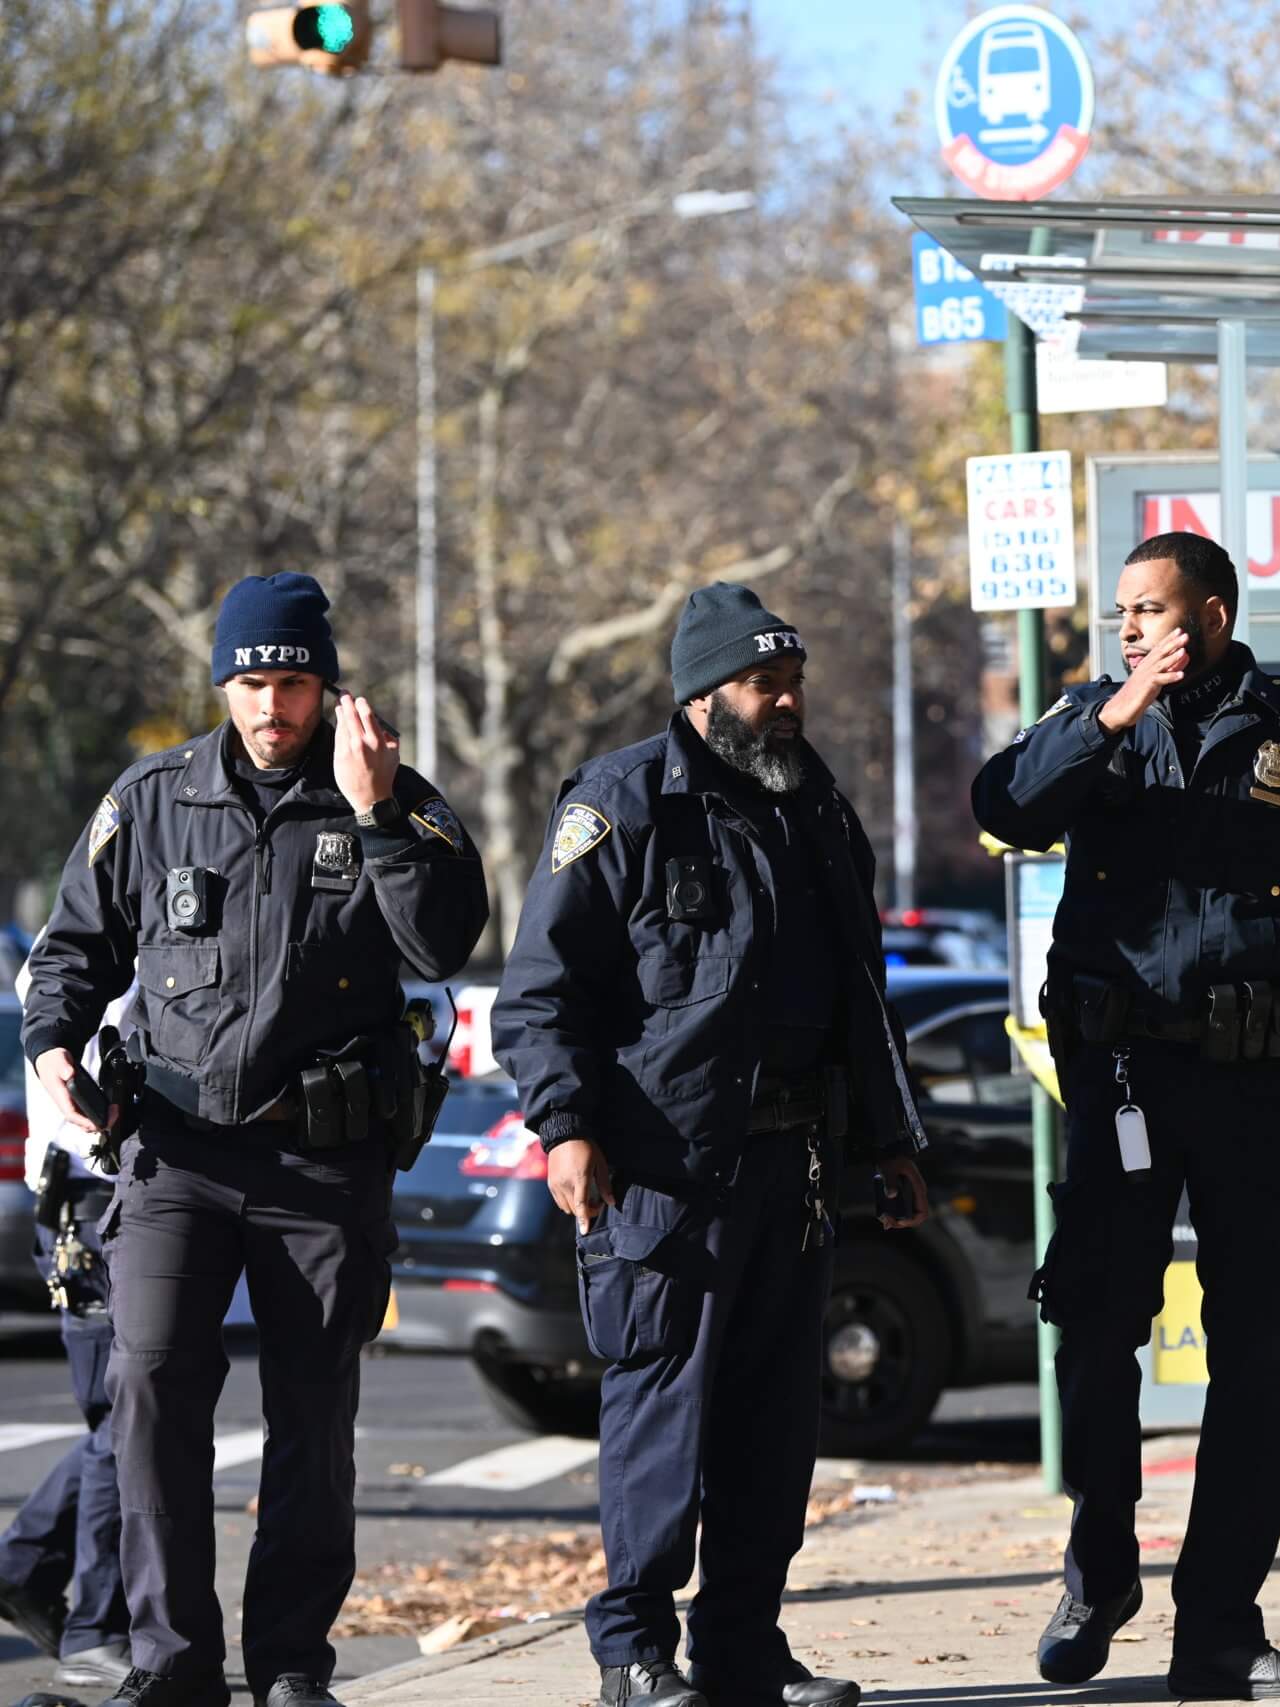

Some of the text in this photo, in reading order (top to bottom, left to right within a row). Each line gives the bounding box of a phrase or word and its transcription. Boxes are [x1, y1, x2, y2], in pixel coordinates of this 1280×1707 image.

[922, 296, 985, 341] B65
[984, 497, 1056, 521] CARS
[991, 552, 1056, 574] 636
[981, 577, 1067, 600] 9595
[234, 644, 311, 666] NYPD
[1159, 1326, 1208, 1351] LA
